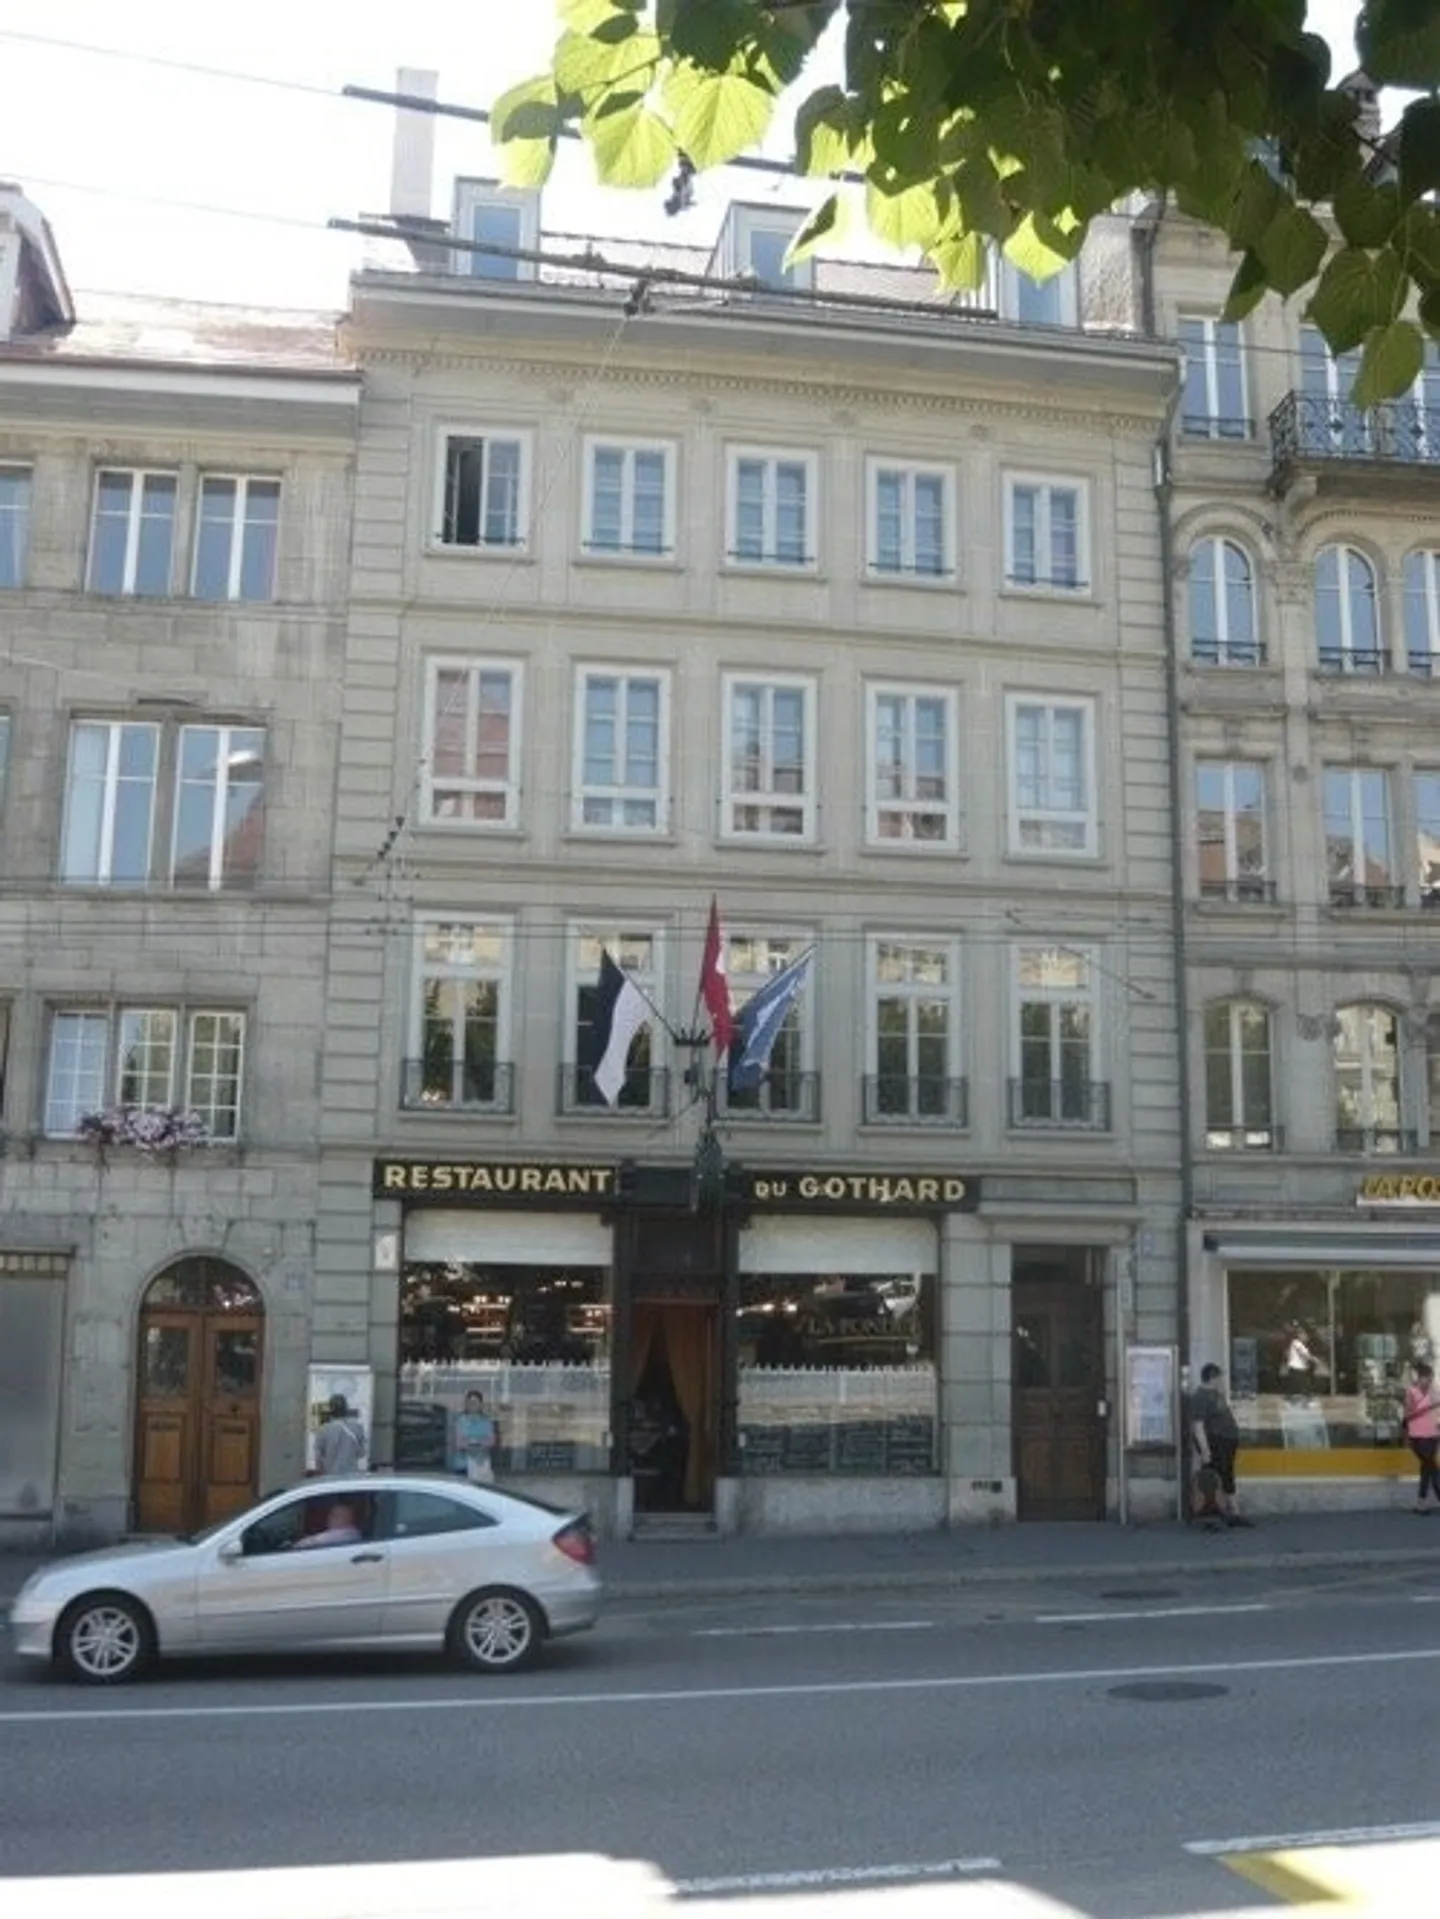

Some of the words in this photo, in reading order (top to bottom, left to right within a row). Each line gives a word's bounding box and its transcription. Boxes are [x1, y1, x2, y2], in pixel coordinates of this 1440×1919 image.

[383, 1163, 612, 1193] RESTAURANT
[754, 1180, 788, 1198] DU
[799, 1175, 966, 1202] GOTHARD
